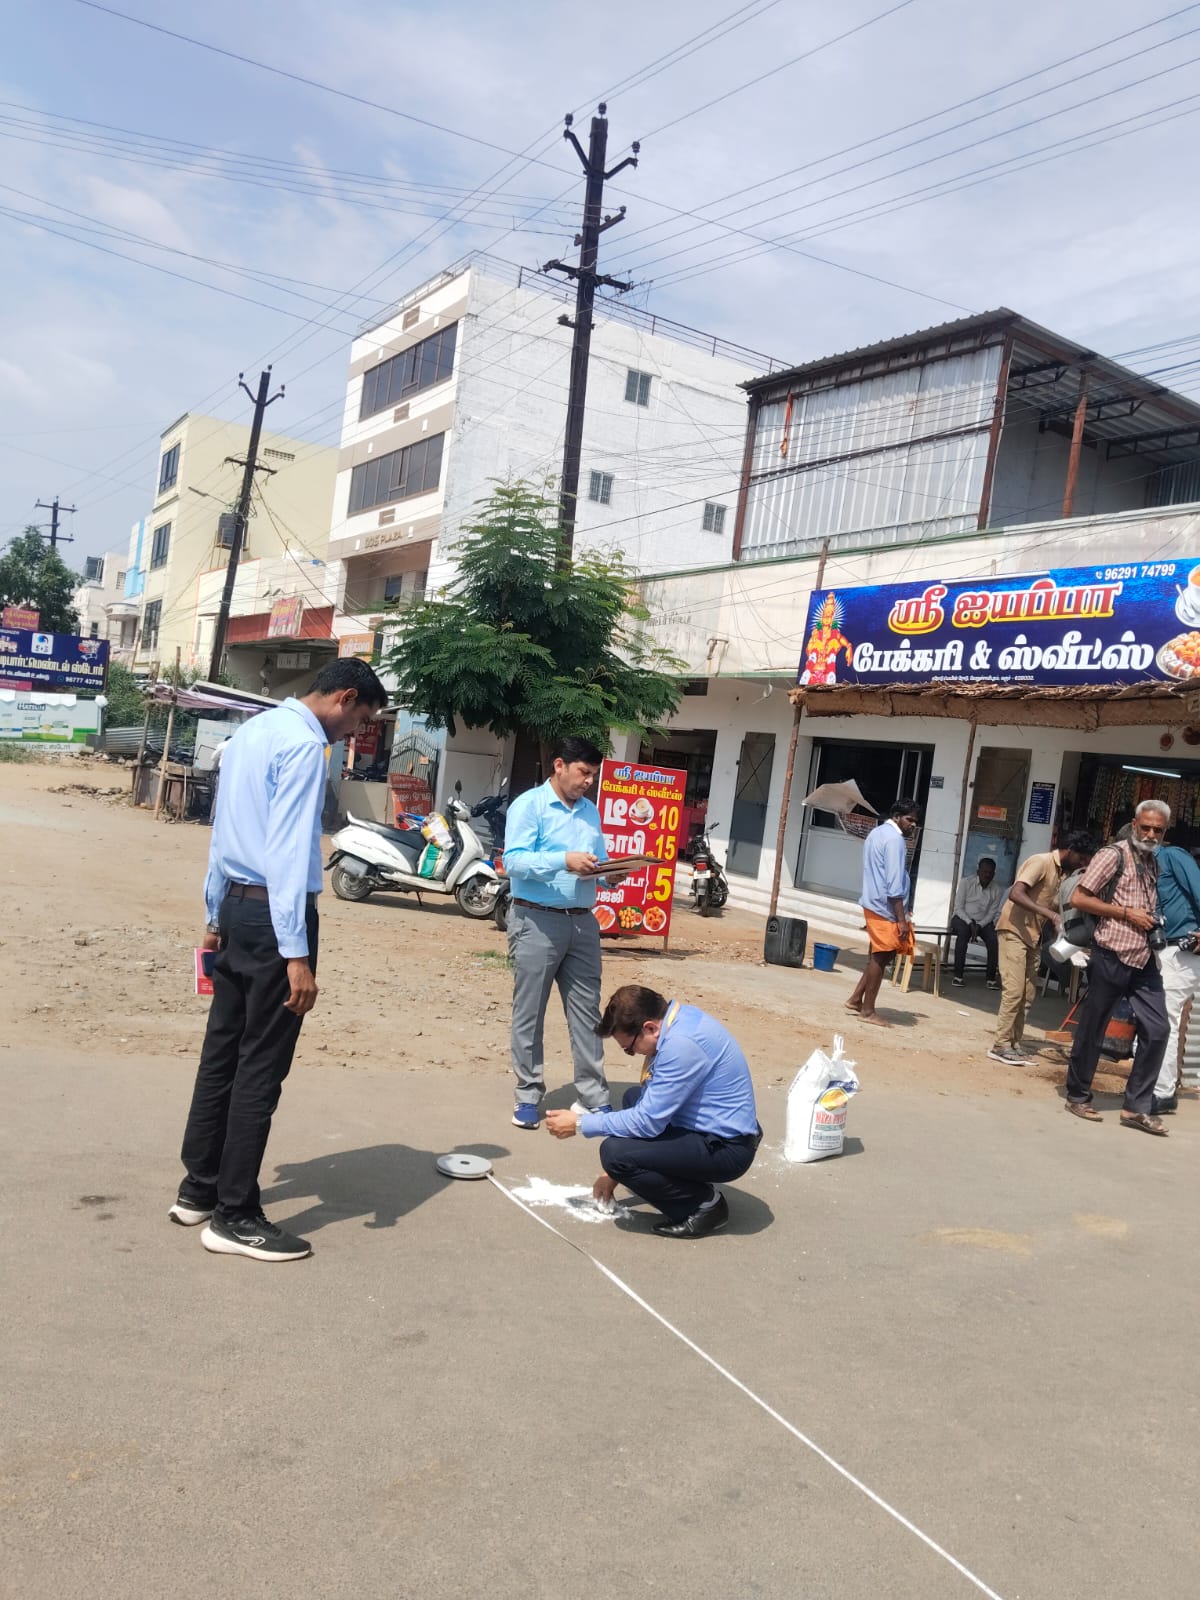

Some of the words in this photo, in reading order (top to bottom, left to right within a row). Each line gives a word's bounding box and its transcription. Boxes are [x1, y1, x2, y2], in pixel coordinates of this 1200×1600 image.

[1105, 567, 1138, 581] 96291
[1141, 564, 1176, 577] 74799
[952, 578, 1123, 628] ஐயப்பா
[853, 638, 964, 672] பேக்கரி
[969, 643, 991, 670] &
[998, 630, 1154, 671] ஸ்வீட்ஸ்
[602, 780, 638, 795] பேக்கரி
[639, 786, 646, 796] &
[646, 786, 683, 801] ஸ்வீட்ஸ்
[658, 805, 679, 832] 10
[655, 834, 676, 861] 15
[653, 868, 673, 902] 5
